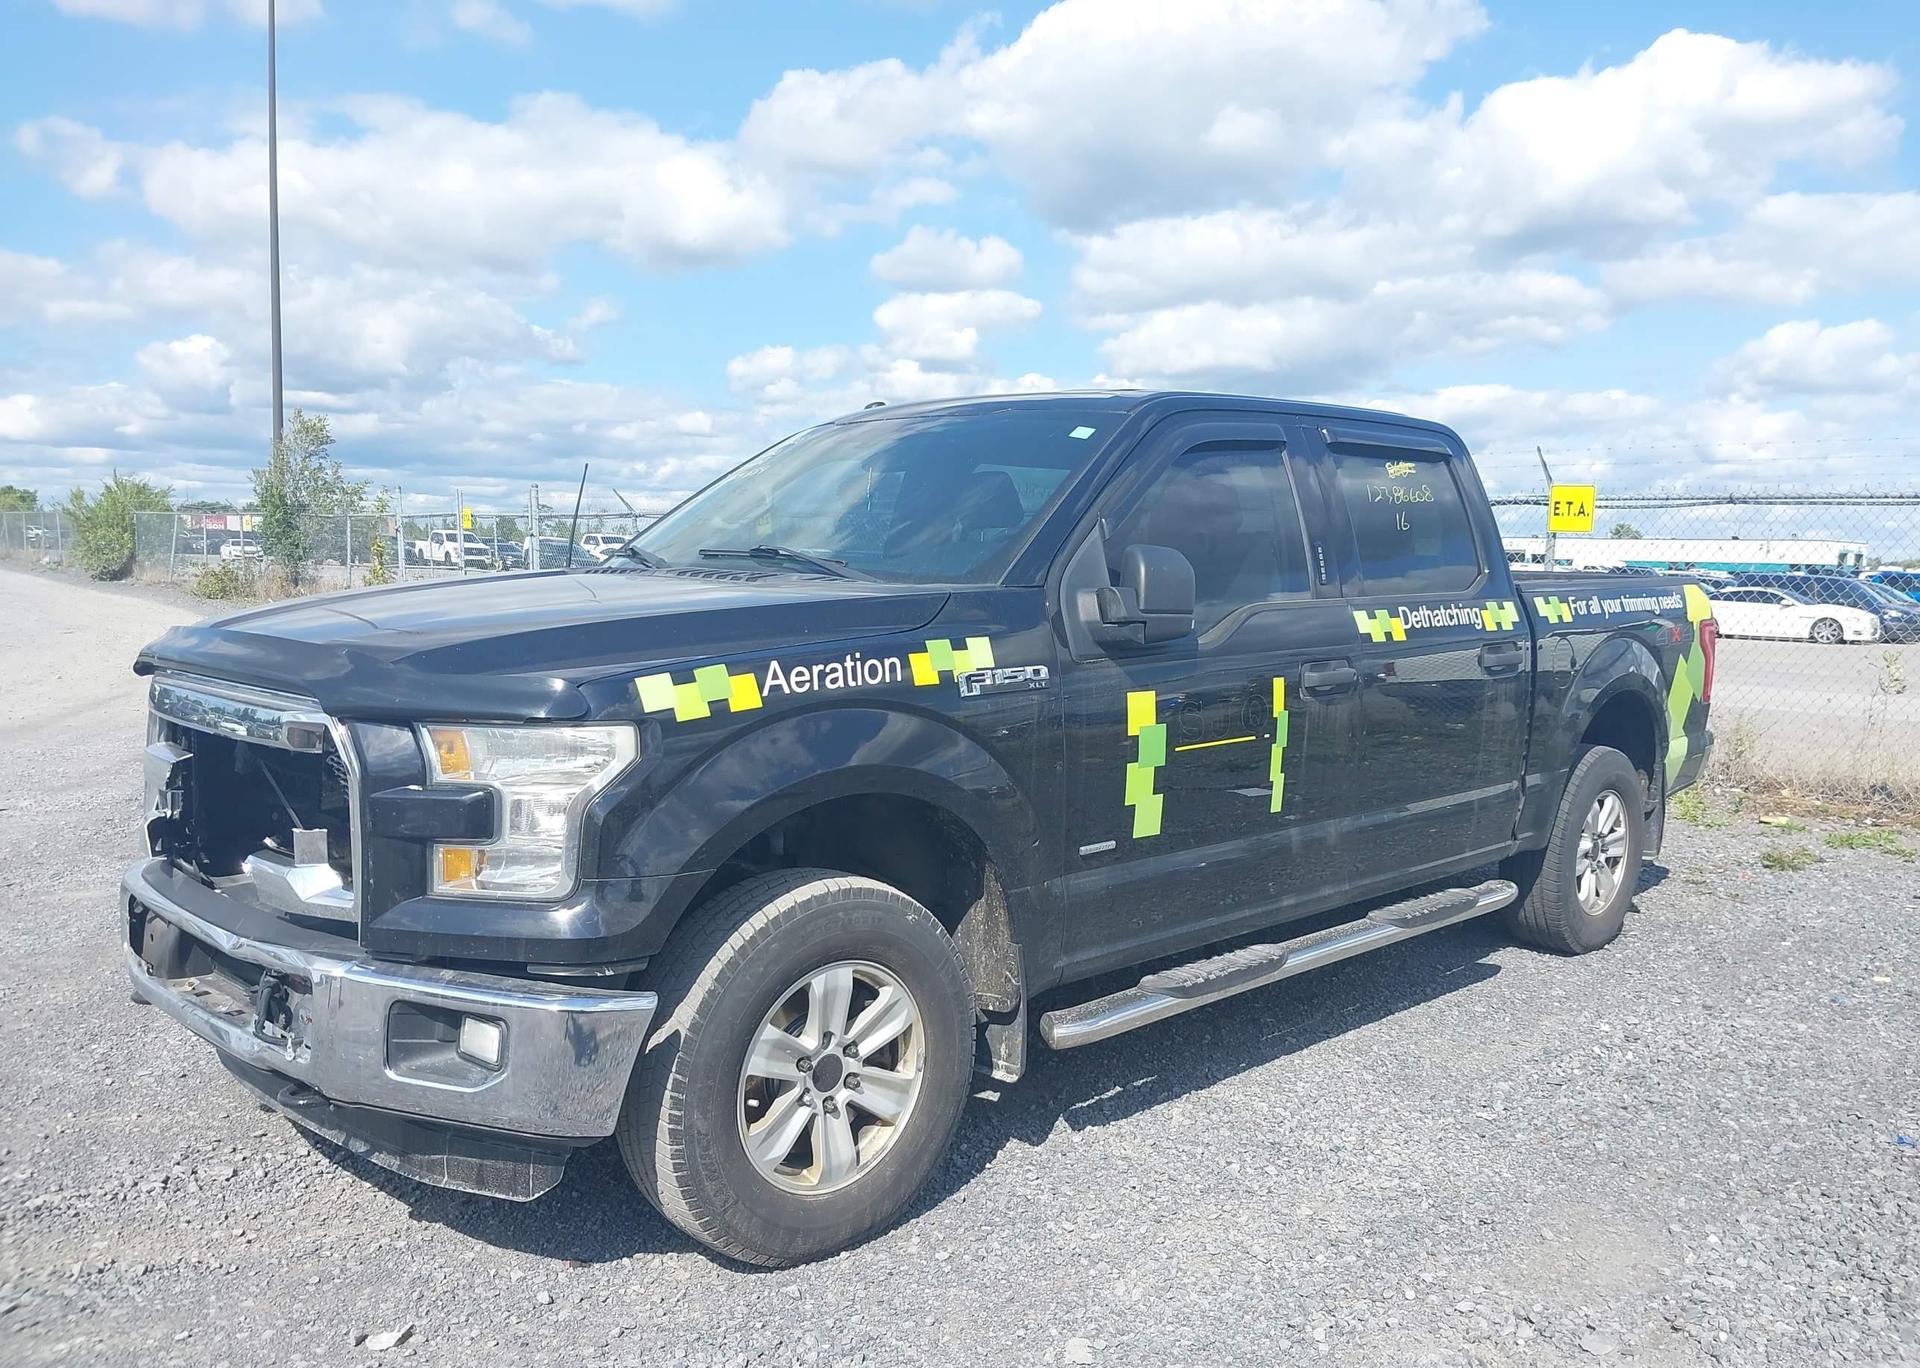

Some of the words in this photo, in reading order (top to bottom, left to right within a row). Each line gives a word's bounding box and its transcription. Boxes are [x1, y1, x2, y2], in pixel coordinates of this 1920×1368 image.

[1553, 501, 1590, 517] E.T.A.
[1395, 511, 1411, 531] 16
[1397, 603, 1483, 630] Dethatching
[1567, 595, 1588, 616] For
[1588, 595, 1602, 615] all
[1600, 599, 1622, 620] your
[1619, 593, 1661, 615] trimming
[1657, 591, 1684, 610] needs
[761, 652, 902, 697] Aeration
[1027, 681, 1047, 690] XLT
